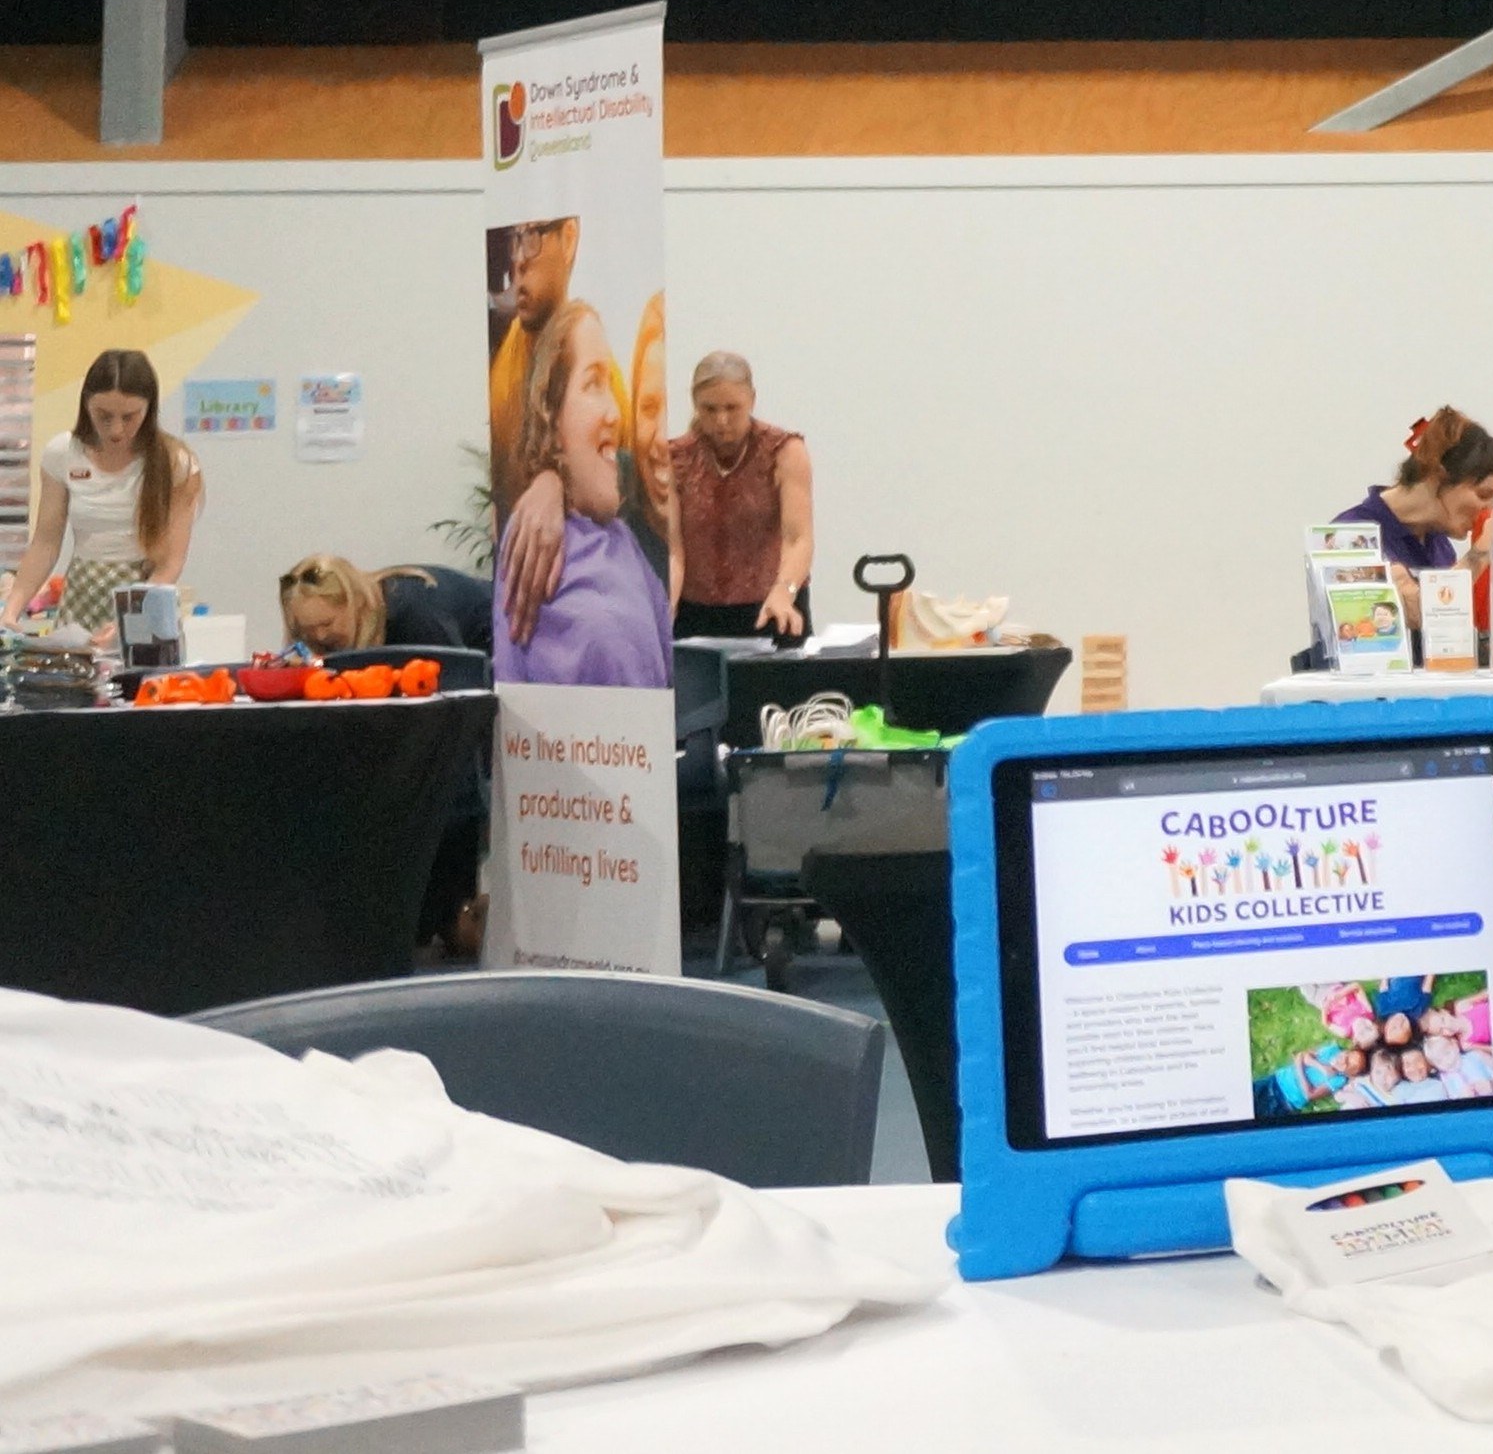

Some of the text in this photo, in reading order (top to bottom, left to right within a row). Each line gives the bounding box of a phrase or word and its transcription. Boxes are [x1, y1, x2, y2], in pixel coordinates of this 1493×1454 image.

[530, 63, 639, 103] Down Syndrome &
[530, 92, 652, 129] Intellectual Disability
[200, 400, 260, 416] Library
[536, 732, 565, 763] live
[571, 734, 653, 773] inclusive,
[519, 789, 633, 824] productive &
[1161, 799, 1377, 839] CABOOLTURE
[521, 842, 639, 886] fulfilling lives
[1170, 891, 1385, 926] KIDS COLLECTIVE
